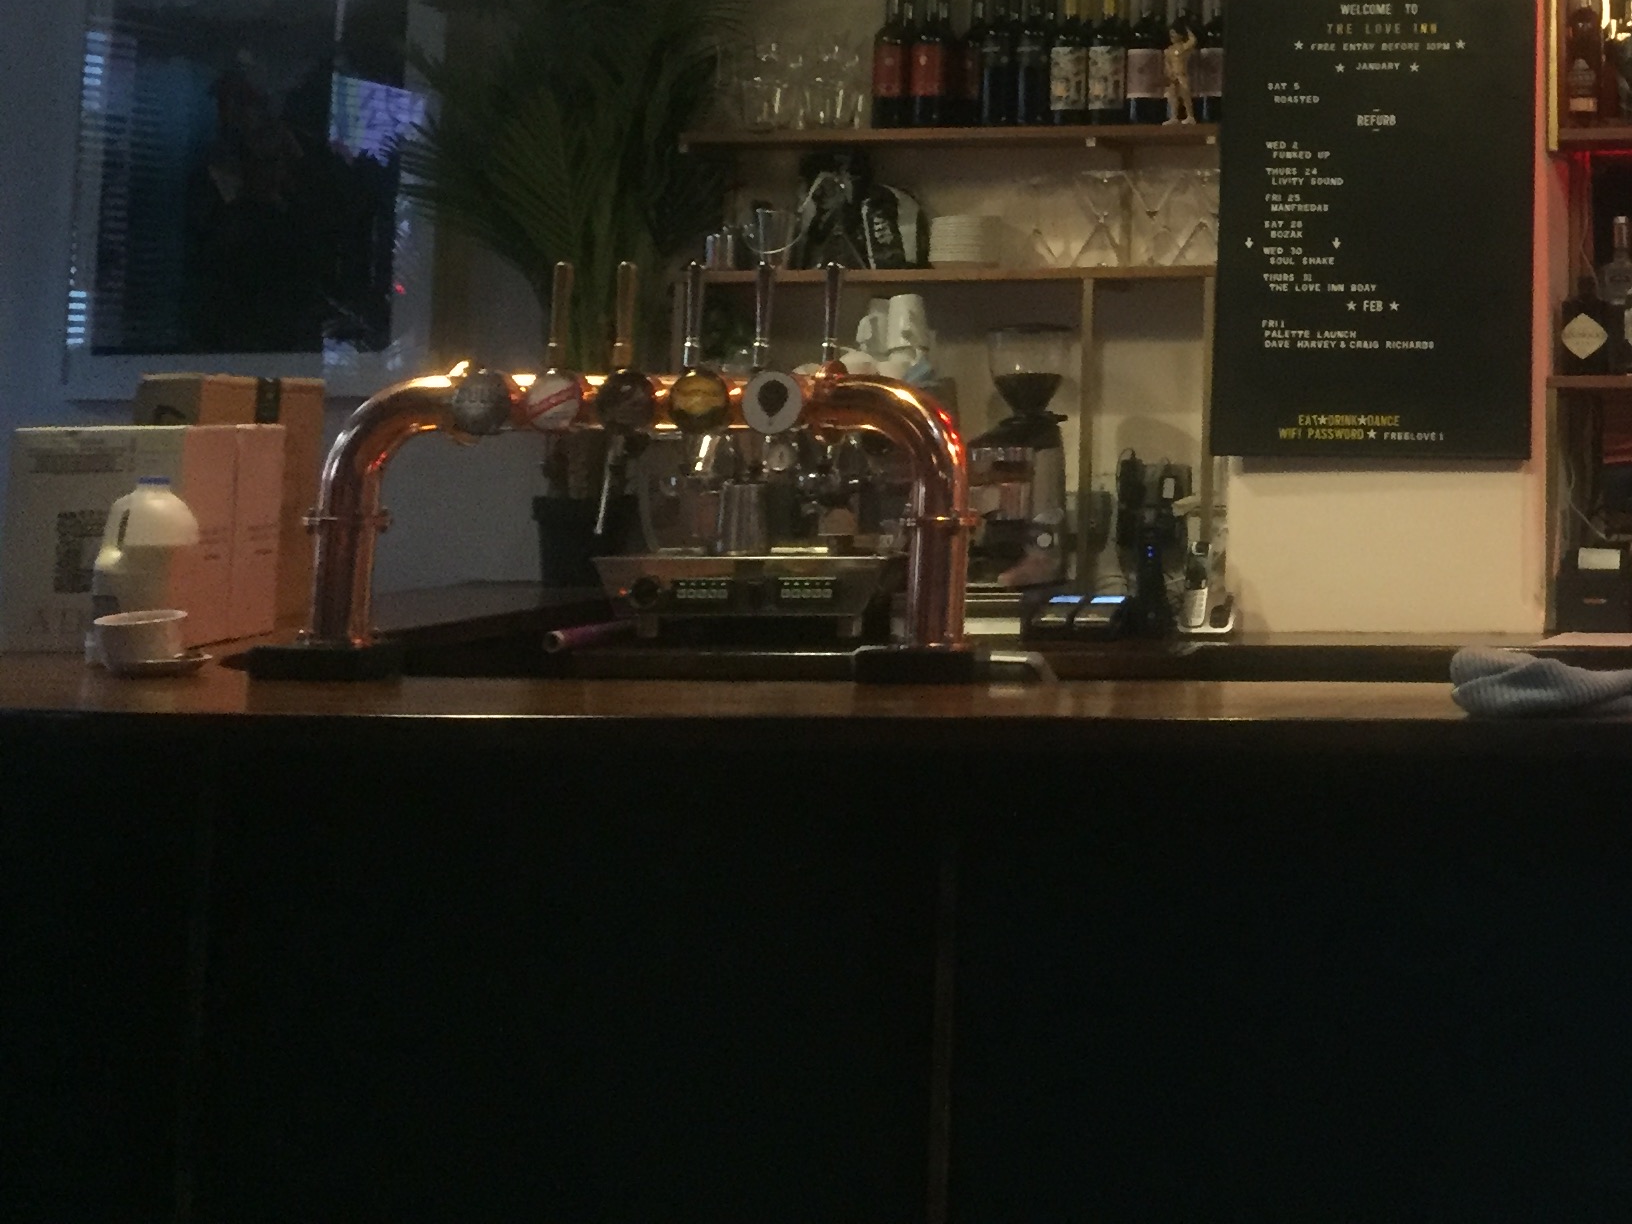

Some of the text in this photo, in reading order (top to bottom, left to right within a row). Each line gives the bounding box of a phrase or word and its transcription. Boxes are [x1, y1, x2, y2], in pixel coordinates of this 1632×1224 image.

[1340, 2, 1419, 16] WELCOME TO
[1326, 23, 1353, 35] THE
[1365, 22, 1401, 35] LOVE
[1355, 61, 1401, 71] JANUARY
[1267, 82, 1288, 91] SAT
[1273, 95, 1320, 104] ROASTED
[1356, 114, 1397, 127] REFURB
[1265, 140, 1287, 150] WED
[1264, 167, 1298, 176] THURS
[1271, 176, 1344, 186] LIVITY SOUND
[1264, 193, 1282, 202] FRI
[1264, 220, 1285, 229] SAT
[1262, 246, 1284, 256] WED
[1269, 256, 1335, 266] SOUL SHAKE
[1262, 272, 1295, 282] THURS
[1268, 282, 1289, 292] THE
[1294, 283, 1321, 292] LOVE
[1350, 283, 1377, 293] BDAY
[1362, 299, 1384, 313] FEB
[1261, 319, 1279, 328] FRI
[1264, 329, 1357, 339] PALETTE LAUNCH
[1264, 339, 1290, 349] DAVE
[1296, 339, 1337, 349] HARVEY
[1385, 340, 1435, 350] RICHARDS
[1307, 427, 1365, 440] PASSWORD
